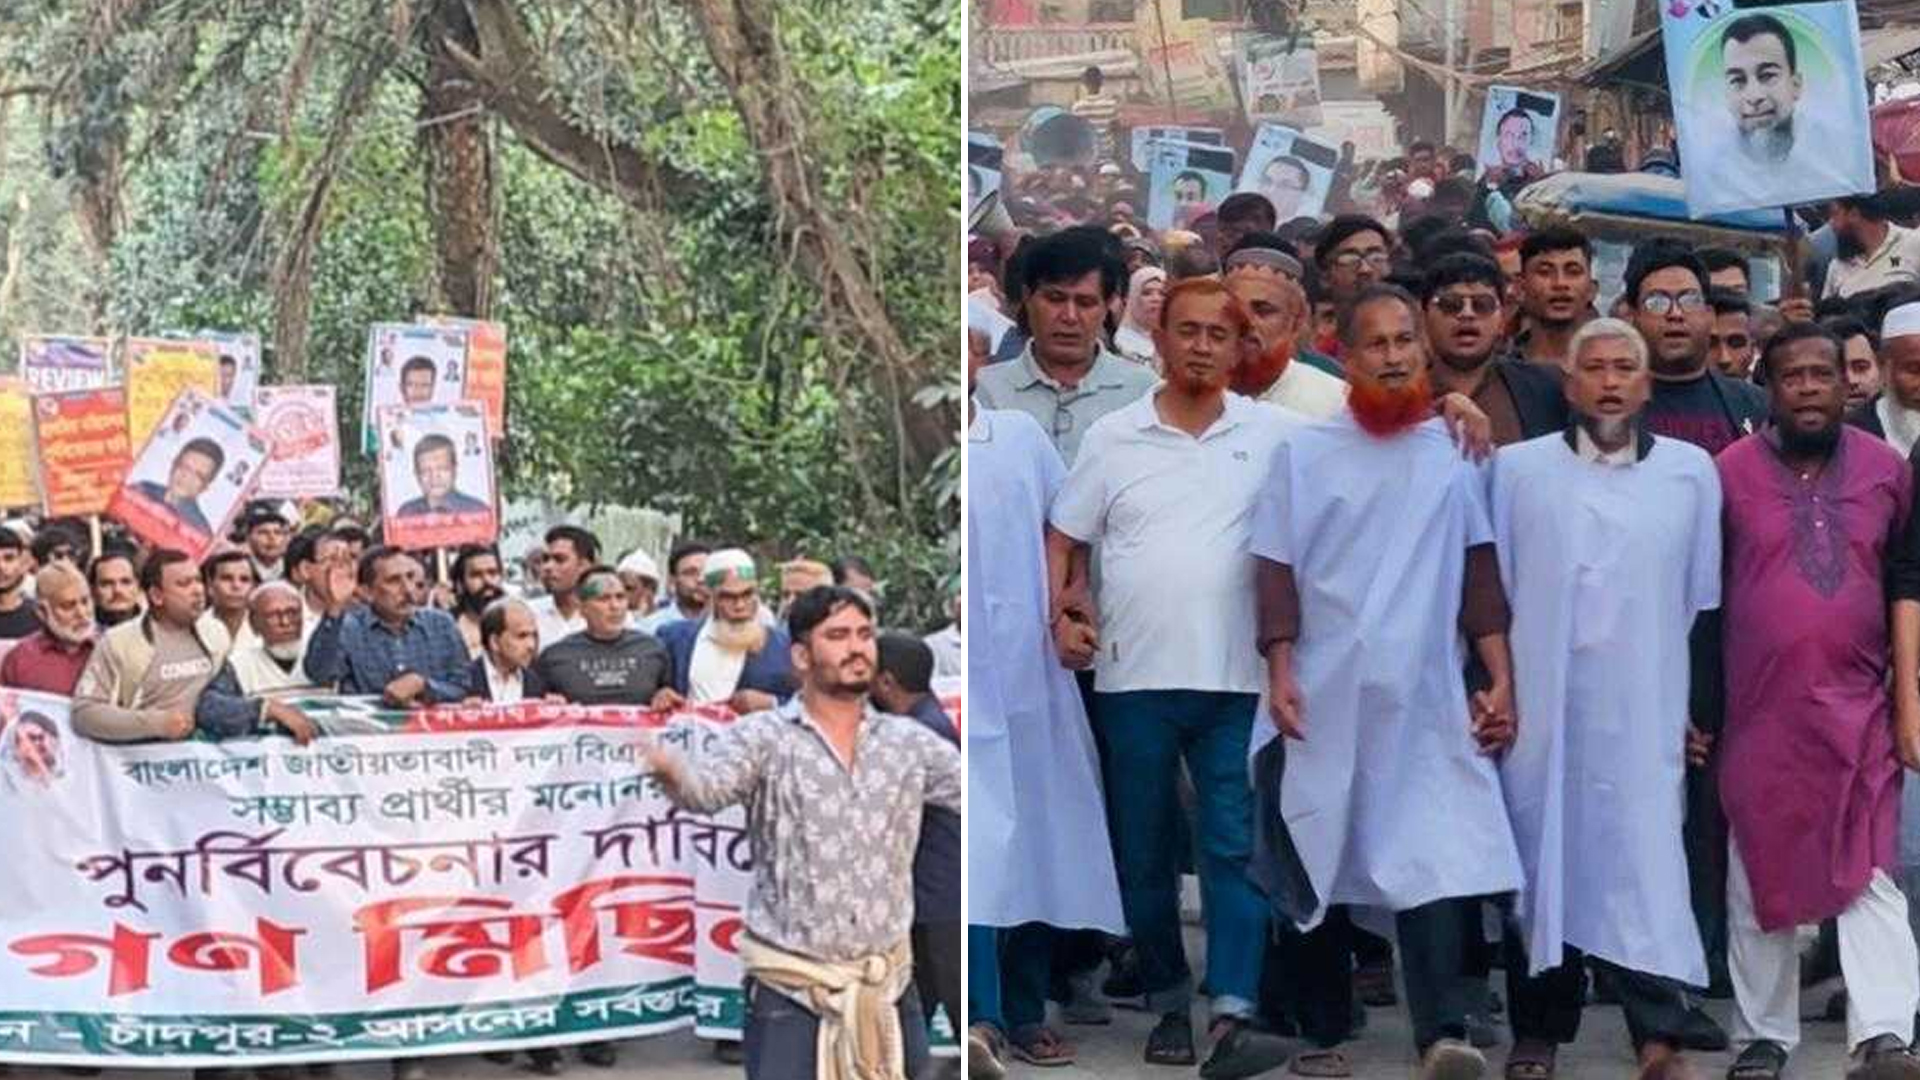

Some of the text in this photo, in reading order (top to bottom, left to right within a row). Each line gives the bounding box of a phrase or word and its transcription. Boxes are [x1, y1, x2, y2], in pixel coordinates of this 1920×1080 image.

[122, 755, 268, 786] বাংলাদেশ
[283, 739, 499, 777] জাতীয়তাবাদী
[512, 743, 567, 768] দল
[228, 795, 364, 825] সম্ভাব্য
[380, 777, 511, 823] প্রার্থীর
[76, 827, 558, 912] পুনর্বিবেচনার
[8, 916, 307, 997] গণ
[365, 1003, 561, 1042] আসনের
